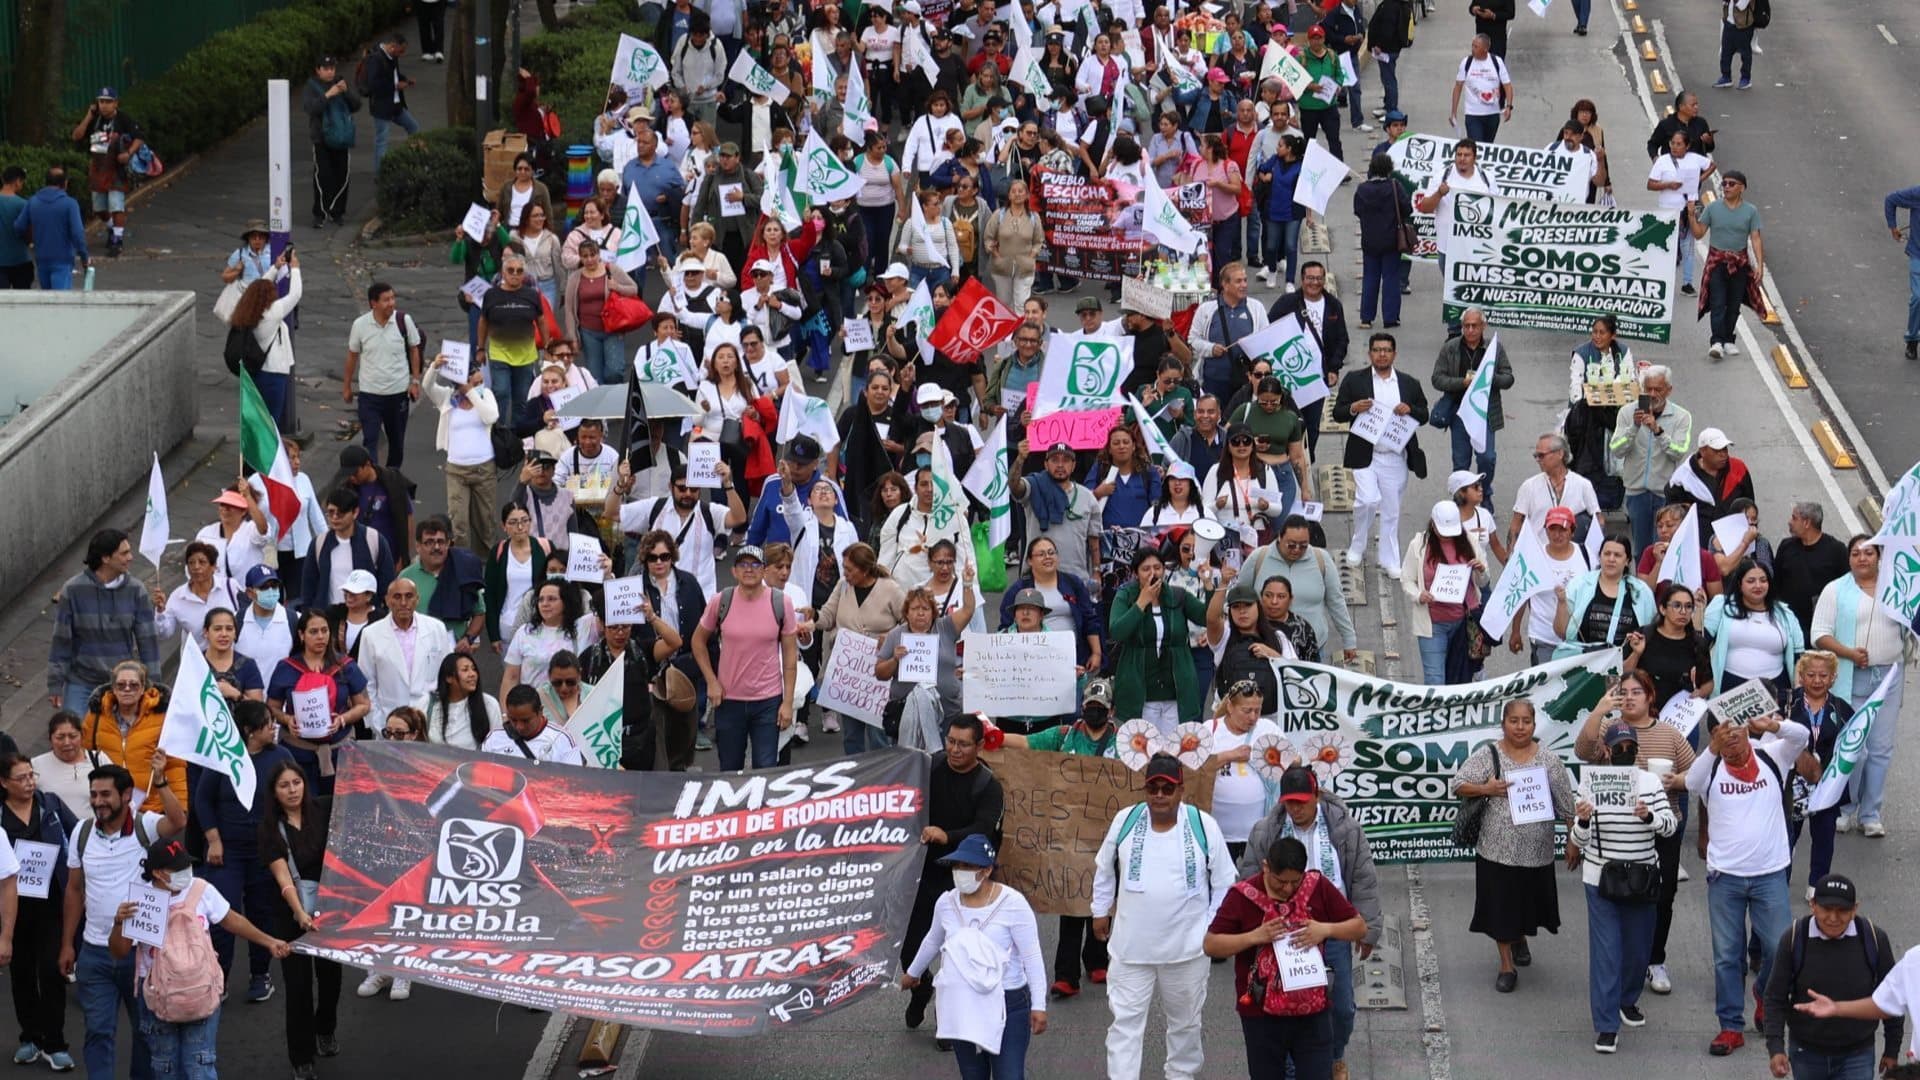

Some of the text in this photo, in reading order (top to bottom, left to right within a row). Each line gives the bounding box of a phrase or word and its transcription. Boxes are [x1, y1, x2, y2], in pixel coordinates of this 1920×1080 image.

[1442, 143, 1574, 172] MCHOACÁN
[1402, 158, 1433, 173] IMSS
[1041, 172, 1086, 187] PUEBLO
[1043, 183, 1109, 200] ESCUCHA
[1180, 200, 1206, 209] IMSS
[1500, 200, 1634, 229] Michoacán
[1453, 223, 1493, 240] IMSS
[1520, 226, 1609, 244] PRESENTE
[1501, 244, 1622, 275] SOMOS
[1458, 263, 1661, 299] IMSS-COPLAMAR
[1461, 287, 1663, 319] ¿Y NUESTRA HOMOLOGACIÓN?
[1359, 421, 1378, 436] IMSS
[1383, 431, 1401, 445] IMSS
[701, 449, 711, 457] YO
[693, 471, 717, 479] IMSS
[573, 563, 599, 573] IMSS
[613, 592, 637, 601] APOYO
[1436, 586, 1460, 596] IMSS
[612, 607, 638, 617] IMSS
[906, 664, 932, 673] IMSS
[307, 697, 318, 705] YO
[1348, 670, 1550, 718] Michoacán
[301, 703, 325, 713] APOYO
[1673, 702, 1695, 718] APOYO
[1683, 698, 1694, 708] YO
[1718, 700, 1728, 710] Yo
[1283, 710, 1339, 733] IMSS
[1382, 700, 1504, 737] PRESENT
[1675, 712, 1686, 721] AL
[1733, 703, 1765, 726] IMSS
[302, 720, 327, 730] IMSS
[1664, 716, 1689, 734] IMSS
[1521, 776, 1534, 784] YO
[1590, 772, 1599, 782] Yo
[673, 760, 859, 820] IMSS
[1516, 784, 1542, 794] APOYO
[1719, 777, 1768, 795] Wilson
[1525, 793, 1535, 801] AL
[1595, 792, 1626, 806] IMSS
[1517, 801, 1547, 814] IMSS
[654, 789, 916, 846] TEPEXI DE RODRIGUEZ
[30, 850, 42, 858] YO
[653, 819, 910, 874] Unido en la lucha
[20, 859, 47, 868] APOYO
[25, 866, 37, 874] AL
[17, 876, 43, 886] MSS
[692, 861, 884, 887] Por un salario digno
[427, 877, 522, 907] IMSS
[689, 877, 875, 903] Por un retiro digno
[144, 893, 156, 903] YO
[687, 889, 875, 917] No mas violaciones
[141, 911, 152, 920] AL
[390, 904, 541, 933] Puebla
[684, 907, 829, 928] a los estatutos
[131, 919, 160, 935] IMSS
[683, 912, 873, 942] Respeto a nuestros
[458, 932, 473, 940] de
[475, 933, 534, 943] Rodriguez
[681, 936, 773, 952] derechos
[430, 948, 512, 967] UN
[522, 952, 672, 981] PASO
[681, 934, 856, 980] ATRAS
[1288, 964, 1318, 977] IMSS
[562, 977, 661, 998] también
[664, 987, 687, 999] es
[693, 985, 720, 1000] tu
[726, 981, 792, 1000] lucha
[613, 1006, 635, 1014] por
[637, 1008, 658, 1016] eso
[661, 1009, 673, 1017] te
[675, 1009, 733, 1019] invitamos
